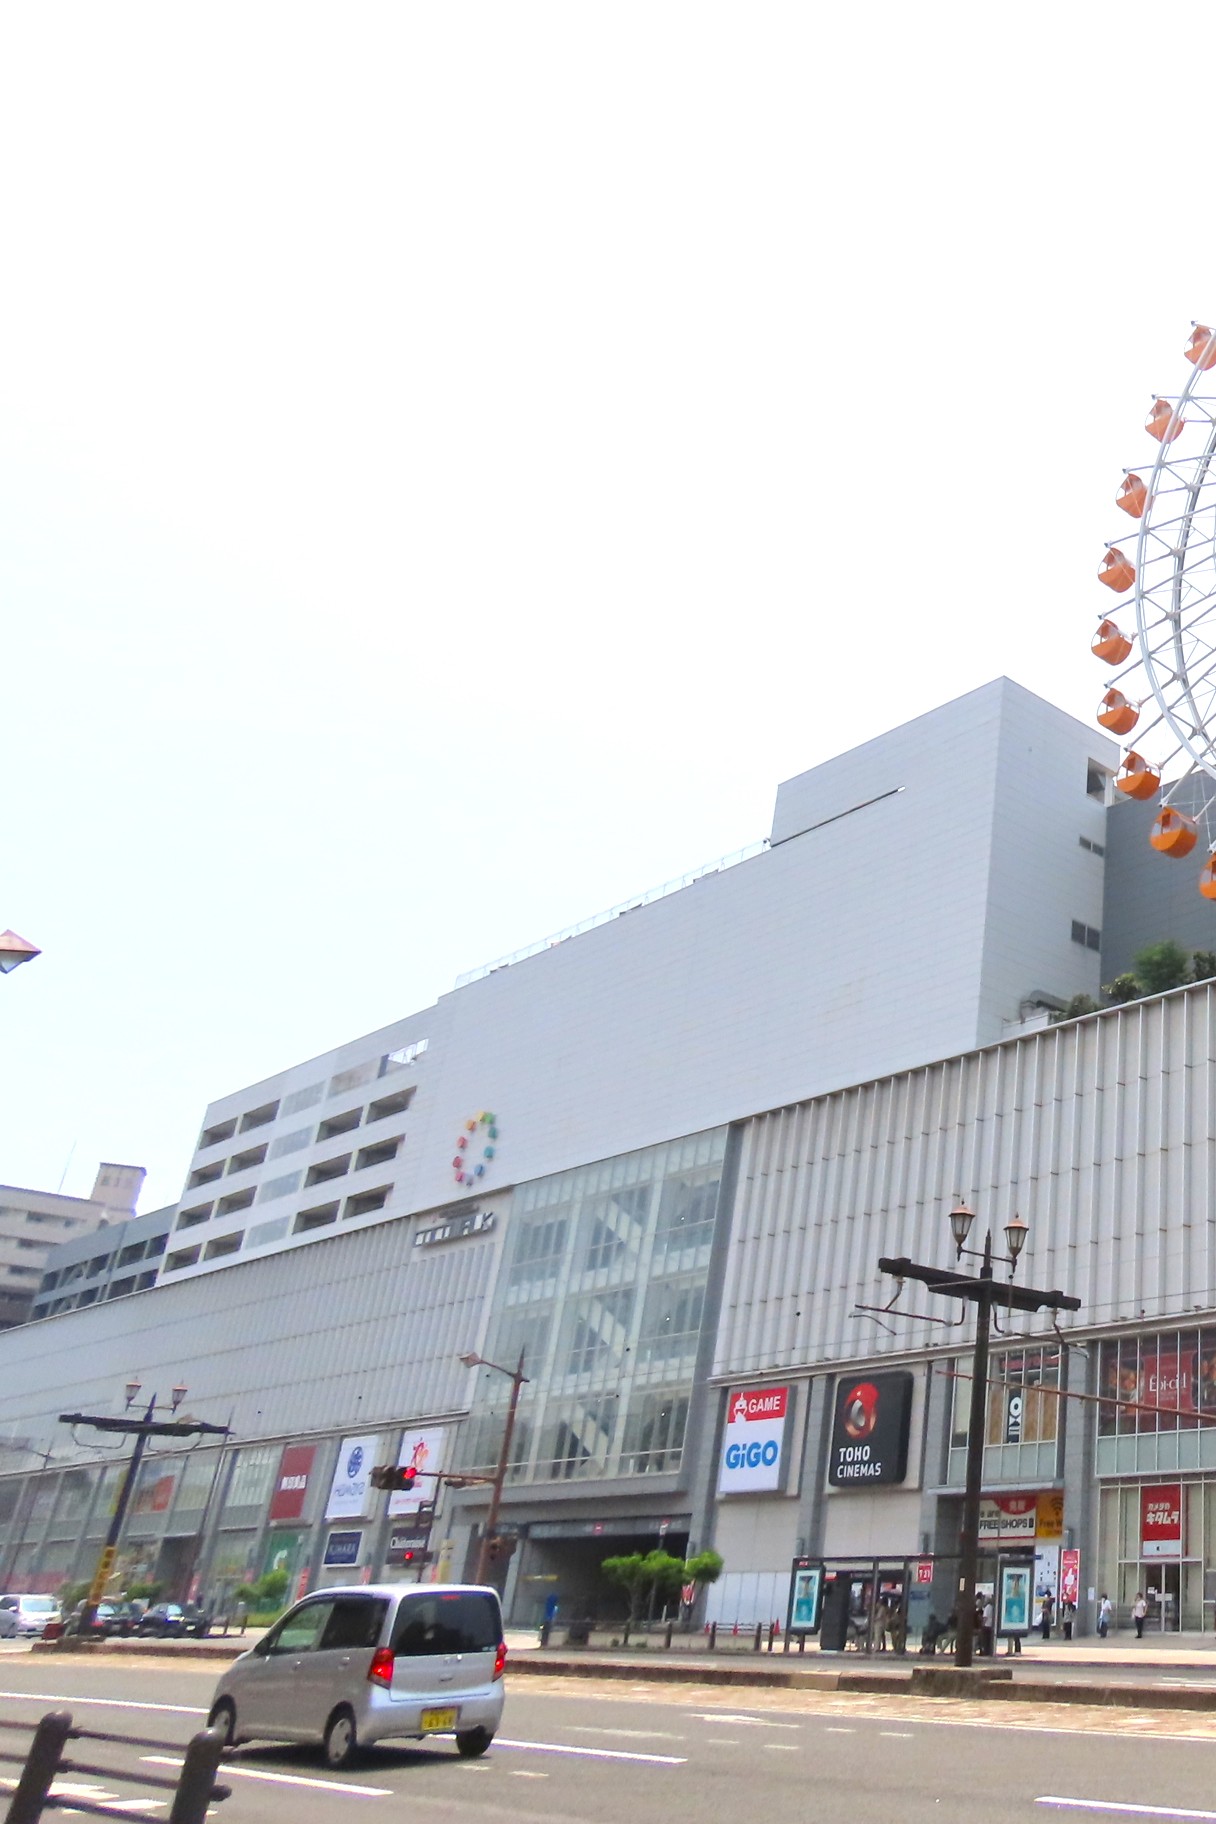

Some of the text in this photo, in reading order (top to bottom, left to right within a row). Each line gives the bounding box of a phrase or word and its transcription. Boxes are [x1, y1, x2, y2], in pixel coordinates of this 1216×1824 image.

[748, 1396, 781, 1414] GAME
[725, 1440, 779, 1469] GiGO
[839, 1445, 871, 1463] TOHO
[836, 1462, 882, 1478] CINEMAS
[1146, 1510, 1180, 1525] キタムラ
